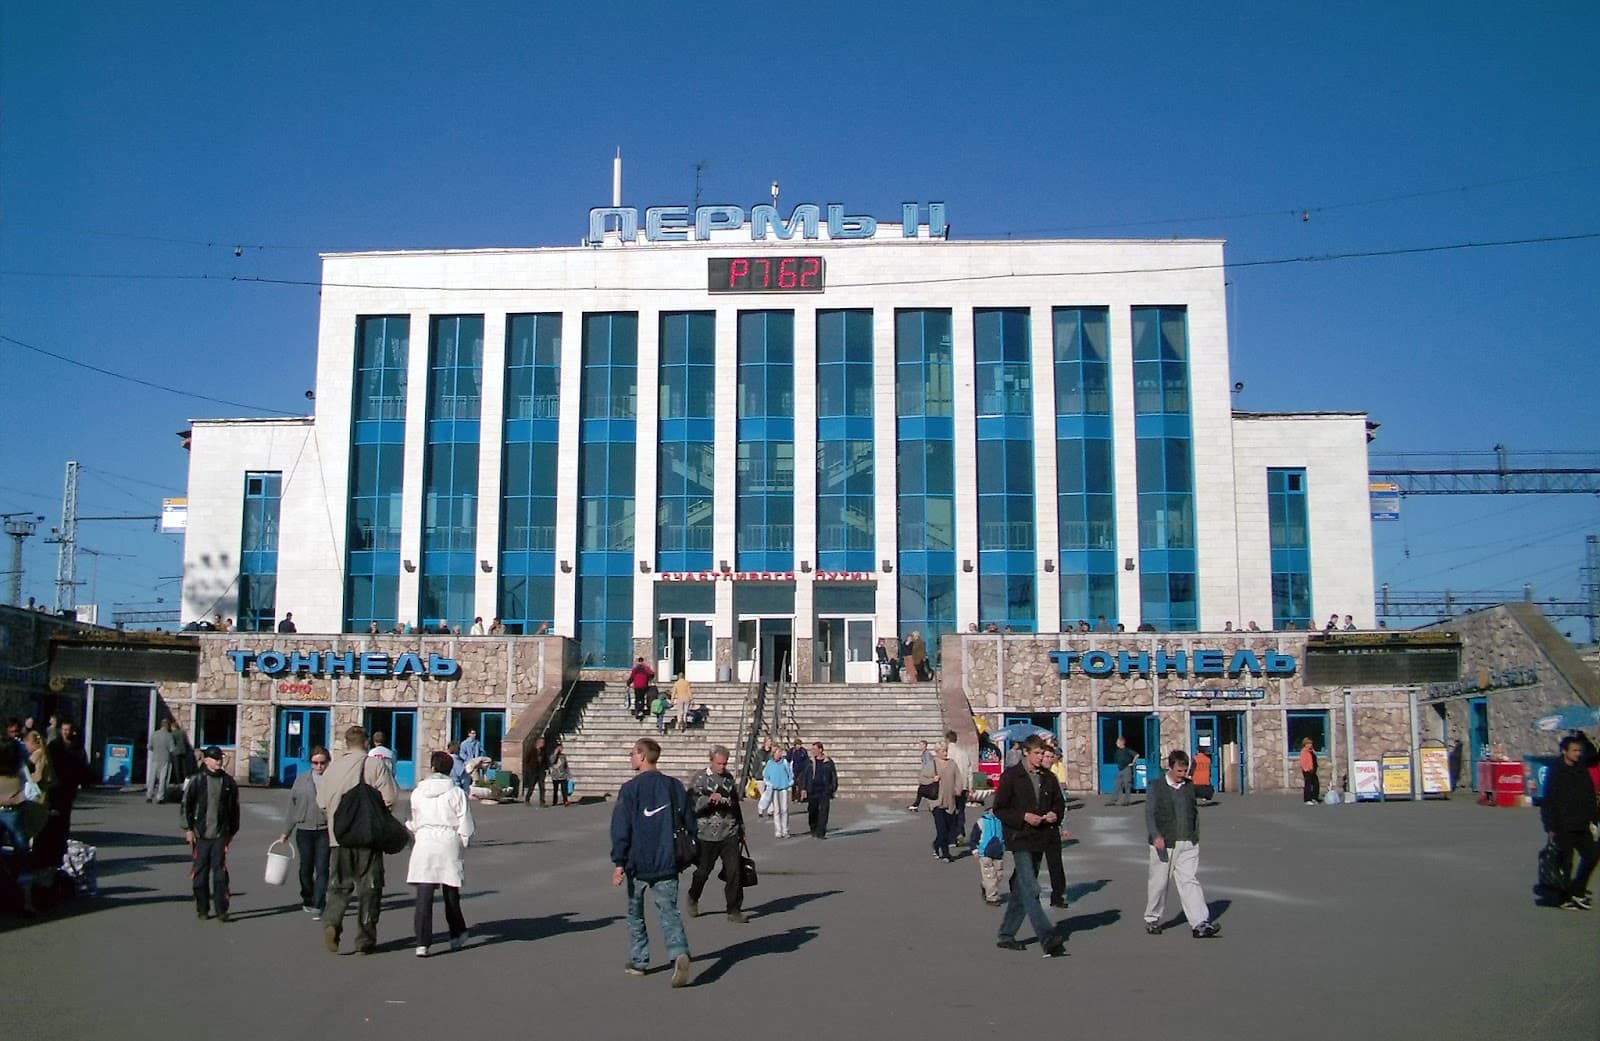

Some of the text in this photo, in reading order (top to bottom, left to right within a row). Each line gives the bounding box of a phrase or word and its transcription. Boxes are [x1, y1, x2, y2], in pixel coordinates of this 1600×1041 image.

[588, 203, 877, 243] ПЕРМЬ
[661, 570, 796, 582] СЧАСТЛИВОГО
[226, 650, 461, 680] ТОННЕЛЬ
[1048, 649, 1297, 678] ТОННЕЛЬ
